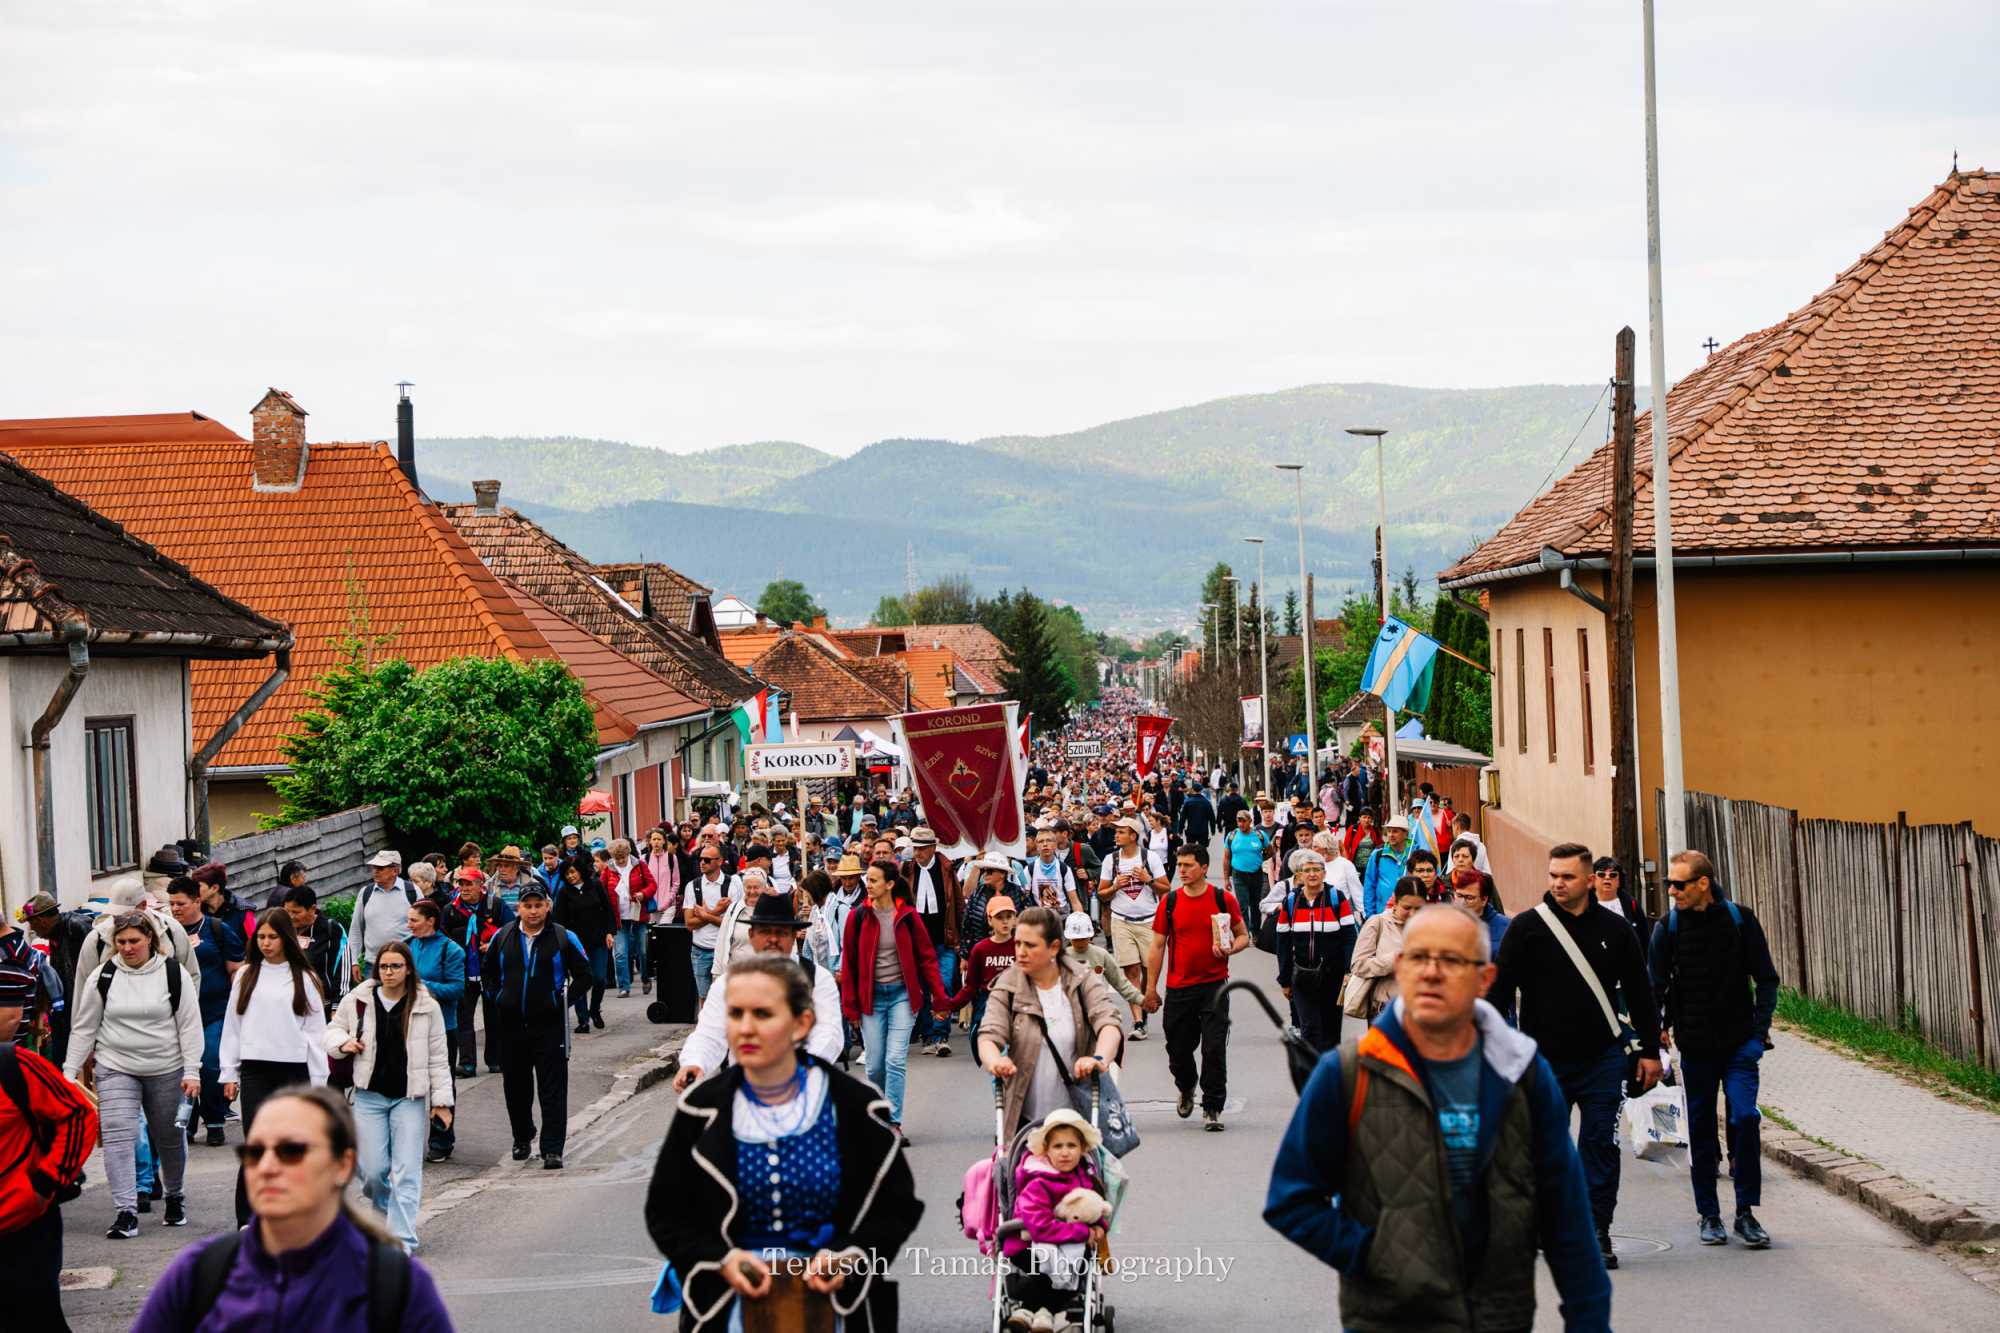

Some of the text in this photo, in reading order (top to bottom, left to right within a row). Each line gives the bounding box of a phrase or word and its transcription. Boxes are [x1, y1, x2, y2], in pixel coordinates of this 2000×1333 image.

[927, 712, 981, 729] KOROND
[764, 753, 837, 768] KOROND
[985, 955, 1015, 967] PARIS
